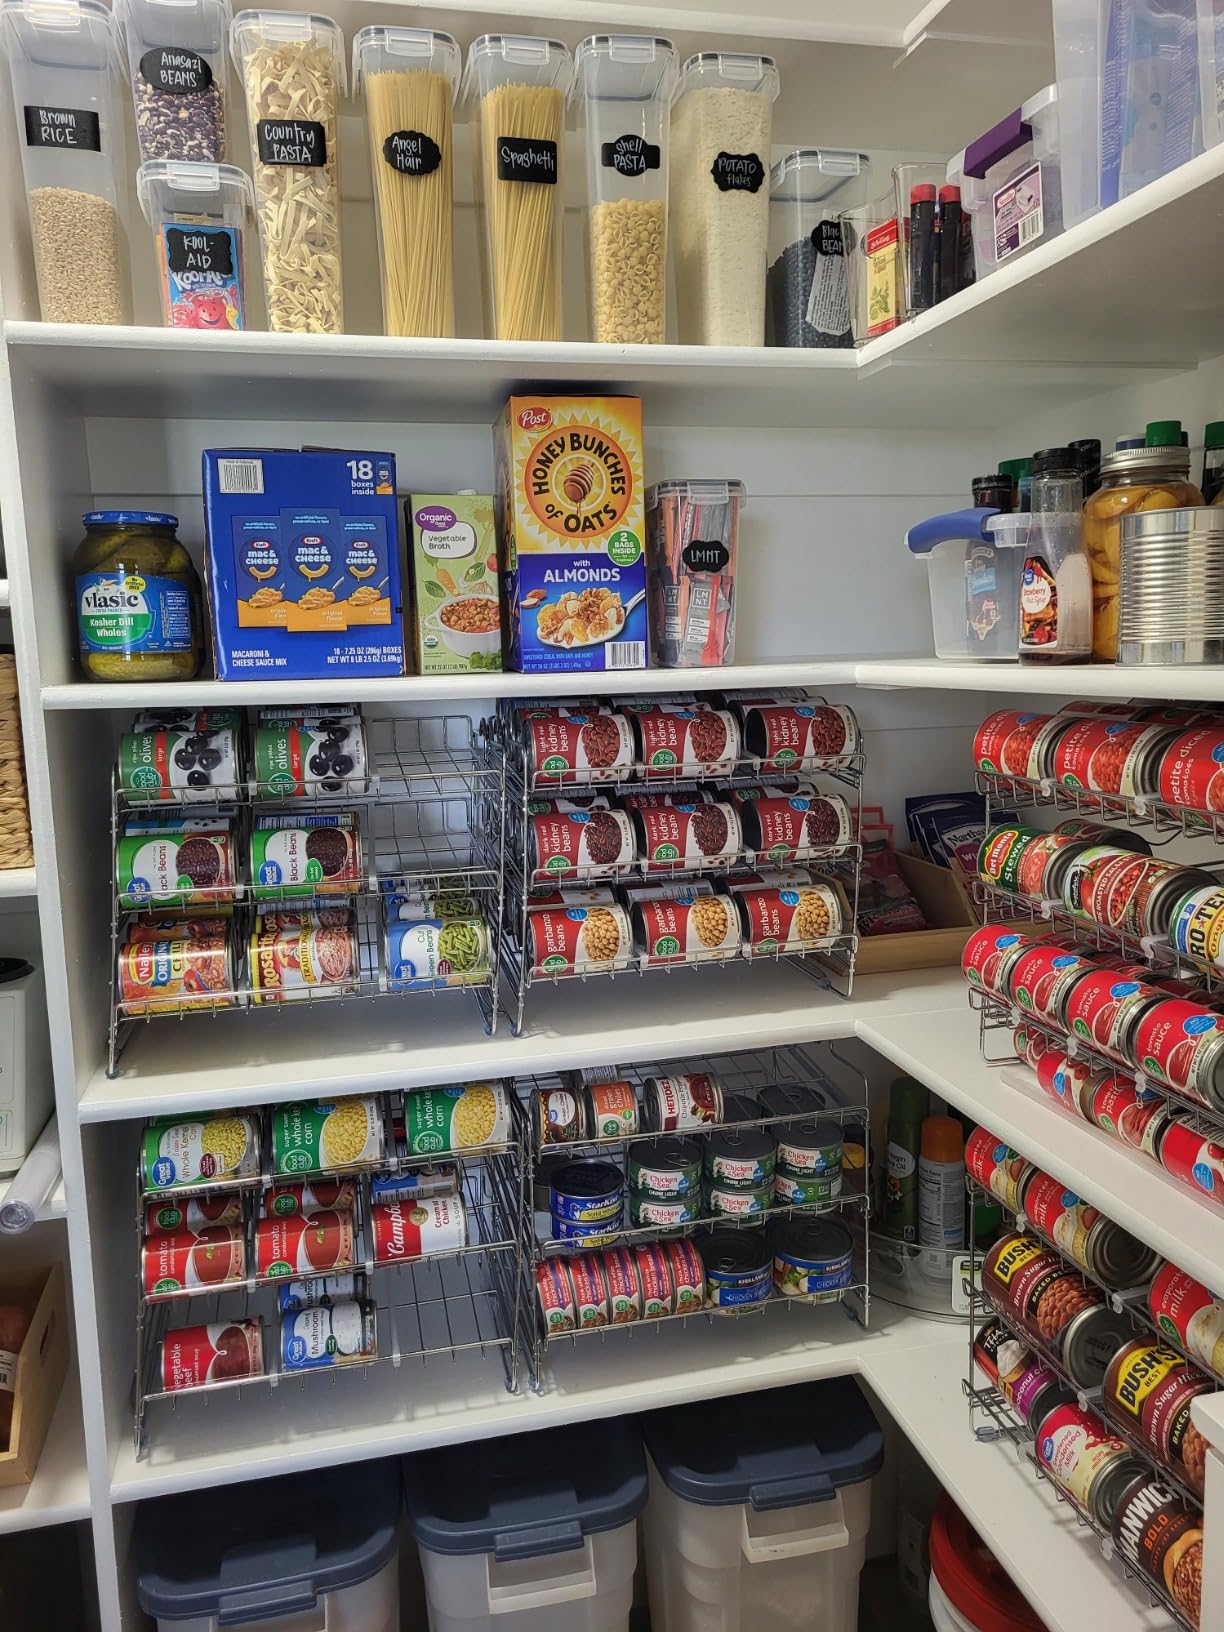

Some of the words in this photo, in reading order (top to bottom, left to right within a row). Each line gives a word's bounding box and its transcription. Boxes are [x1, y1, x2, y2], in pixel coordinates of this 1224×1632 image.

[160, 51, 202, 73] Anasazi
[159, 69, 197, 87] BEANS
[39, 109, 76, 127] Brown
[41, 127, 78, 145] RICE
[264, 122, 315, 149] Country
[392, 136, 421, 154] Angel
[272, 145, 313, 164] PASTA
[397, 154, 421, 170] Hair
[501, 146, 555, 172] Spaghetti
[613, 154, 647, 171] PASTA
[718, 156, 757, 174] POTATO
[727, 173, 752, 187] flakes
[185, 253, 212, 268] AID
[522, 411, 547, 425] Post
[347, 460, 374, 480] 18
[533, 437, 566, 496] HONEY
[569, 432, 626, 495] BUNCHES
[351, 480, 374, 488] boxes
[351, 487, 375, 496] inside
[419, 513, 452, 523] Organic
[545, 504, 563, 521] of
[564, 503, 617, 533] OATS
[428, 535, 467, 543] Vegetable
[620, 532, 627, 542] 2
[269, 550, 277, 558] &
[297, 547, 319, 555] mac
[320, 546, 328, 555] &
[367, 550, 375, 558] &
[573, 559, 590, 567] with
[690, 550, 720, 564] LMNT
[543, 567, 621, 583] ALMONDS
[85, 592, 139, 609] vlasic
[696, 590, 708, 598] LM
[90, 618, 117, 627] Kosher
[118, 618, 134, 626] Dill
[96, 628, 127, 637] Wholes
[231, 650, 264, 658] MACARONI
[232, 659, 255, 667] CHEESE
[255, 658, 274, 666] SAUCE
[275, 658, 287, 666] MIX
[549, 723, 558, 752] kidney
[560, 724, 568, 752] beans
[658, 718, 667, 747] kidney
[781, 715, 789, 746] kidney
[790, 717, 799, 745] beans
[142, 735, 153, 763] olives
[278, 738, 288, 770] olives
[1063, 732, 1081, 769] petite
[1170, 760, 1184, 804] petite
[1183, 758, 1194, 805] tomatoes
[551, 822, 560, 853] kidney
[561, 823, 570, 852] beans
[660, 811, 669, 841] kidney
[669, 814, 678, 841] beans
[775, 810, 784, 842] kidney
[784, 812, 793, 841] beans
[289, 832, 297, 857] Beans
[994, 831, 1014, 857] Monte
[159, 845, 167, 873] Beans
[290, 859, 299, 882] Black
[990, 855, 1000, 874] Del
[1004, 834, 1031, 882] Stewed
[1095, 877, 1108, 907] ROASTED
[666, 908, 677, 932] beans
[757, 897, 771, 936] garbanzo
[770, 908, 780, 935] beans
[543, 914, 557, 952] garbanzo
[555, 924, 566, 951] beans
[138, 943, 151, 978] Nalley
[973, 940, 988, 965] sauce
[1025, 958, 1043, 985] sauce
[1077, 988, 1092, 1013] tomato
[1082, 987, 1100, 1017] sauce
[1146, 1023, 1162, 1052] tomato
[1153, 1022, 1172, 1056] sauce
[661, 1080, 675, 1115] HERDEZ
[423, 1100, 434, 1128] whole
[435, 1104, 444, 1127] corn
[292, 1117, 303, 1146] whole
[304, 1122, 313, 1144] corn
[423, 1136, 431, 1151] food
[291, 1155, 299, 1170] food
[298, 1154, 306, 1169] club
[787, 1150, 814, 1161] Chicken
[794, 1158, 807, 1166] Sea
[157, 1162, 167, 1185] Great
[650, 1175, 678, 1184] Chicken
[725, 1164, 752, 1173] Chicken
[658, 1181, 671, 1189] Sea
[586, 1196, 618, 1209] StarKist
[651, 1208, 679, 1218] Chicken
[721, 1198, 748, 1207] Chicken
[1040, 1203, 1049, 1228] milk
[272, 1225, 280, 1259] tomato
[159, 1241, 168, 1276] tomato
[1018, 1251, 1035, 1264] BEST
[1013, 1278, 1026, 1308] Brown
[1024, 1260, 1045, 1279] Sugar
[1031, 1276, 1051, 1302] BAKED
[729, 1293, 753, 1302] CHICKEN
[1169, 1285, 1185, 1317] milk
[311, 1310, 319, 1355] Mushroom
[172, 1343, 182, 1388] vegetable
[1119, 1346, 1184, 1409] BUSH'S
[1144, 1369, 1161, 1388] BEST
[1157, 1380, 1178, 1411] Sugar
[1151, 1410, 1164, 1446] Brown
[1171, 1409, 1190, 1445] BAKED
[1052, 1430, 1072, 1465] Sweetened
[1056, 1430, 1081, 1475] Condensed
[1064, 1448, 1075, 1468] Milk
[1143, 1514, 1169, 1550] BOLD
